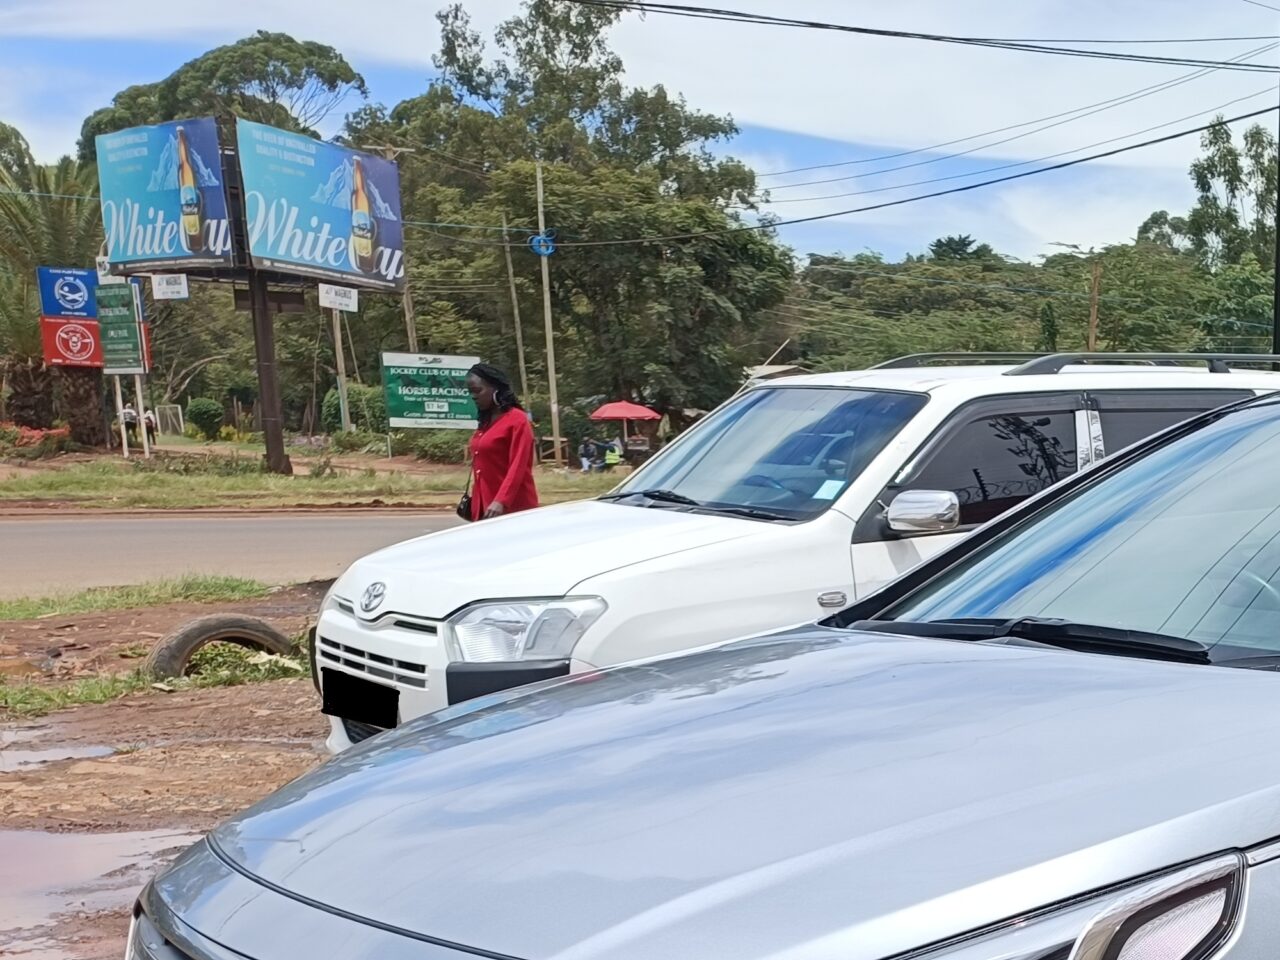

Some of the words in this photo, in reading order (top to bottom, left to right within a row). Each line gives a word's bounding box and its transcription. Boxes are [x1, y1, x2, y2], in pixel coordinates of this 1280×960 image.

[101, 198, 178, 257] White
[246, 190, 348, 267] White
[390, 367, 418, 375] JOCKEY
[419, 368, 439, 376] CLUB
[398, 386, 430, 396] HORSE
[431, 387, 470, 397] RACING
